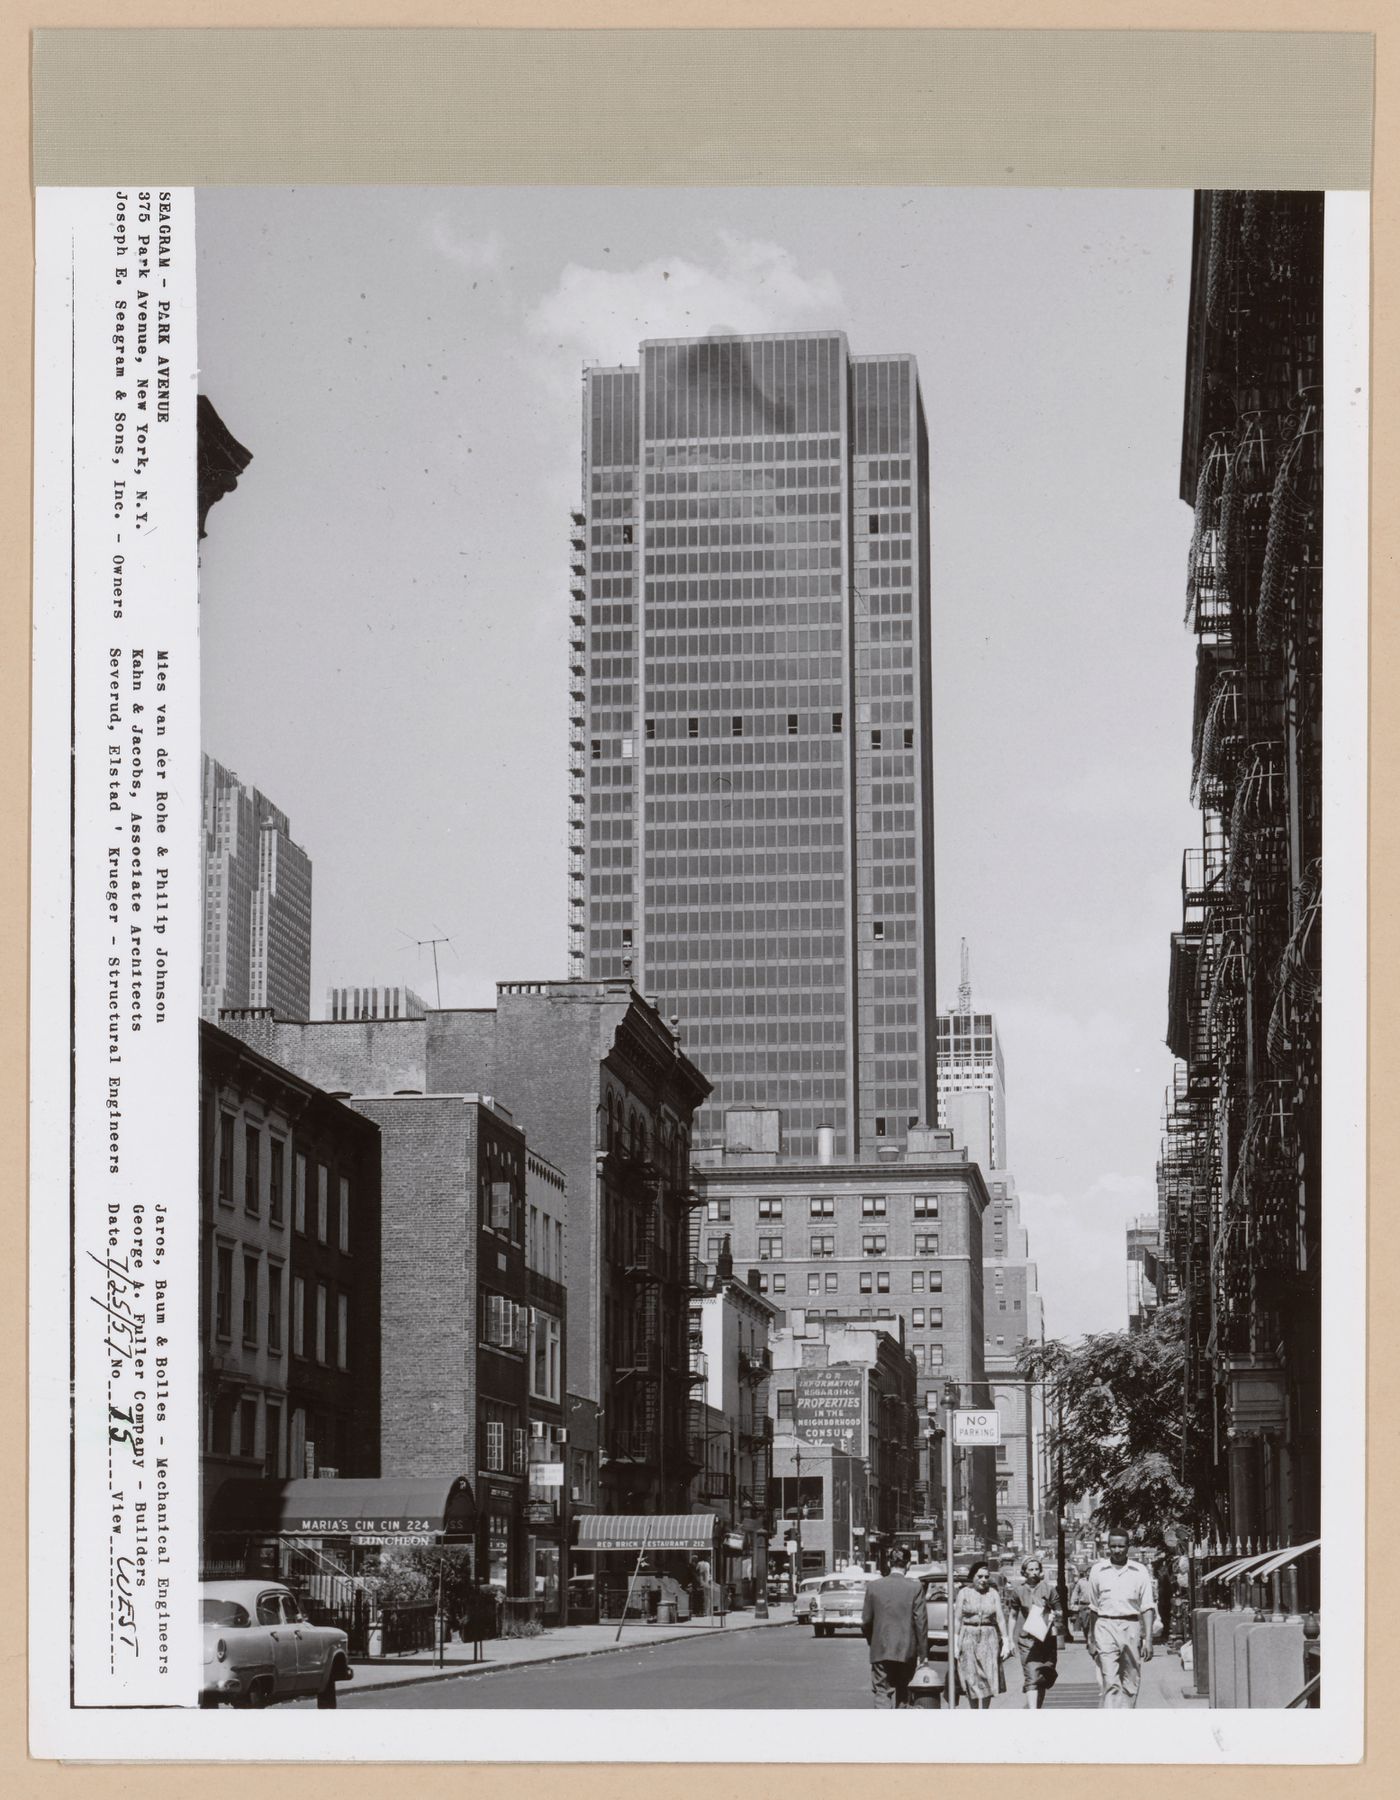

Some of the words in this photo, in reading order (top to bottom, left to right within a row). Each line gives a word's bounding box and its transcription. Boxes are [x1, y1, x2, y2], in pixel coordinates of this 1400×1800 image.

[113, 192, 128, 255] Joseph
[138, 192, 150, 222] 375
[158, 192, 171, 267] SEAGRAM
[115, 268, 127, 285] E.
[137, 235, 150, 278] Park
[111, 301, 126, 376] Seagram
[134, 290, 148, 362] Avenue,
[157, 301, 170, 344] PARK
[115, 391, 127, 400] &
[137, 379, 148, 410] New
[157, 356, 169, 422] AVENUE
[111, 413, 126, 463] Sons,
[133, 424, 148, 474] York,
[113, 481, 125, 518] Inc.
[135, 491, 147, 529] N.Y.
[112, 556, 124, 618] Owners
[107, 649, 121, 730] Severud,
[131, 649, 143, 690] Kahn
[156, 651, 168, 691] Mies
[132, 704, 144, 713] &
[156, 704, 165, 735] van
[108, 746, 121, 811] Elstad
[128, 725, 143, 797] Jacobs,
[156, 749, 168, 779] der
[156, 792, 168, 833] Rohe
[130, 813, 142, 911] Associate
[156, 847, 168, 856] &
[105, 848, 120, 922] Krueger
[153, 869, 168, 933] Philip
[130, 925, 142, 1031] Architects
[155, 948, 167, 1023] Johnson
[108, 958, 121, 1063] Structural
[105, 1078, 121, 1173] Engineers
[107, 1204, 120, 1247] Date
[131, 1205, 144, 1269] George
[152, 1204, 166, 1264] Jaros,
[87, 1251, 139, 1359] 7/25/57
[129, 1281, 144, 1298] A.
[155, 1280, 167, 1323] Baum
[132, 1316, 146, 1379] Fuller
[156, 1336, 168, 1346] &
[110, 1360, 122, 1378] No
[155, 1358, 168, 1421] Bolles
[797, 1398, 860, 1408] PROPERTIES
[967, 1416, 987, 1426] NO
[133, 1391, 146, 1467] Company
[806, 1428, 853, 1437] CONSUL
[959, 1428, 995, 1437] PARKING
[110, 1492, 124, 1535] View
[156, 1459, 169, 1563] Mechanical
[302, 1520, 349, 1530] MARIA'S
[355, 1520, 375, 1530] CIN
[381, 1520, 400, 1530] CIN
[406, 1520, 430, 1530] 224
[135, 1503, 147, 1586] Builders
[357, 1535, 430, 1546] LUNCHEON
[116, 1556, 139, 1657] WEST
[154, 1579, 170, 1673] Engineers
